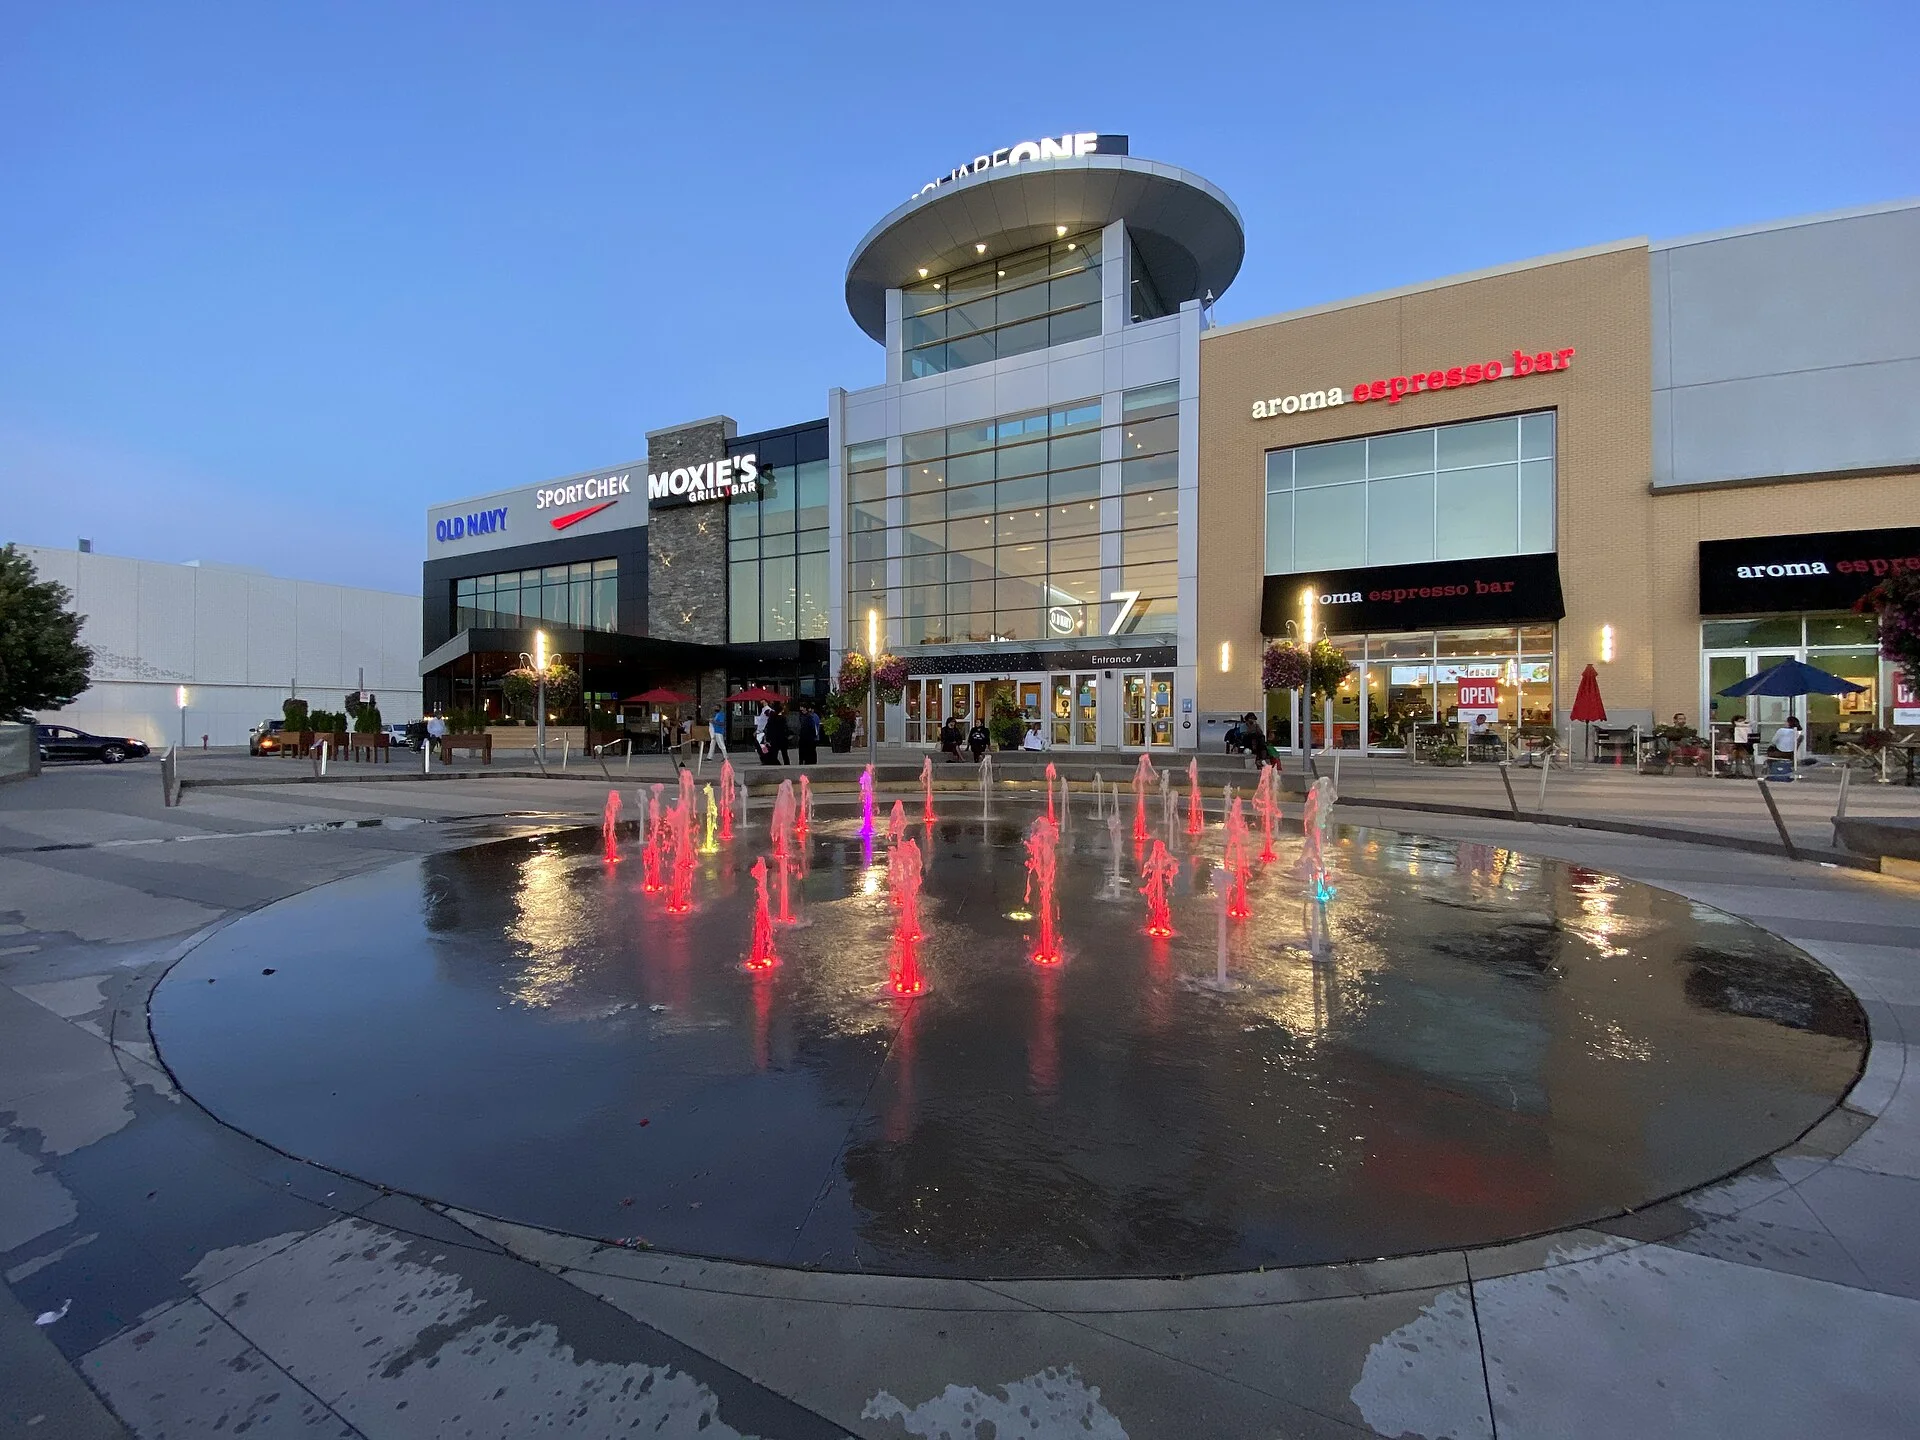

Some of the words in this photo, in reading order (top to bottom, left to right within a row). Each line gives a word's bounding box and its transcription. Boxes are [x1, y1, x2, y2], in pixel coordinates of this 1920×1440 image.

[911, 147, 1009, 200] UARE
[1008, 132, 1098, 167] ONE
[1252, 387, 1344, 420] aroma
[1352, 358, 1504, 404] espresso
[1511, 346, 1576, 377] bar
[648, 453, 758, 500] MOXIE'S
[688, 487, 725, 504] GRILL
[731, 481, 757, 496] BAR
[436, 516, 465, 542] OLD
[467, 506, 508, 536] NAVY
[1737, 559, 1829, 579] aroma
[1368, 582, 1469, 603] espresso
[1474, 579, 1515, 595] bar
[1108, 591, 1141, 635] 7
[1091, 655, 1132, 665] Entrance
[1135, 653, 1142, 663] 7
[1460, 686, 1496, 705] OPEN
